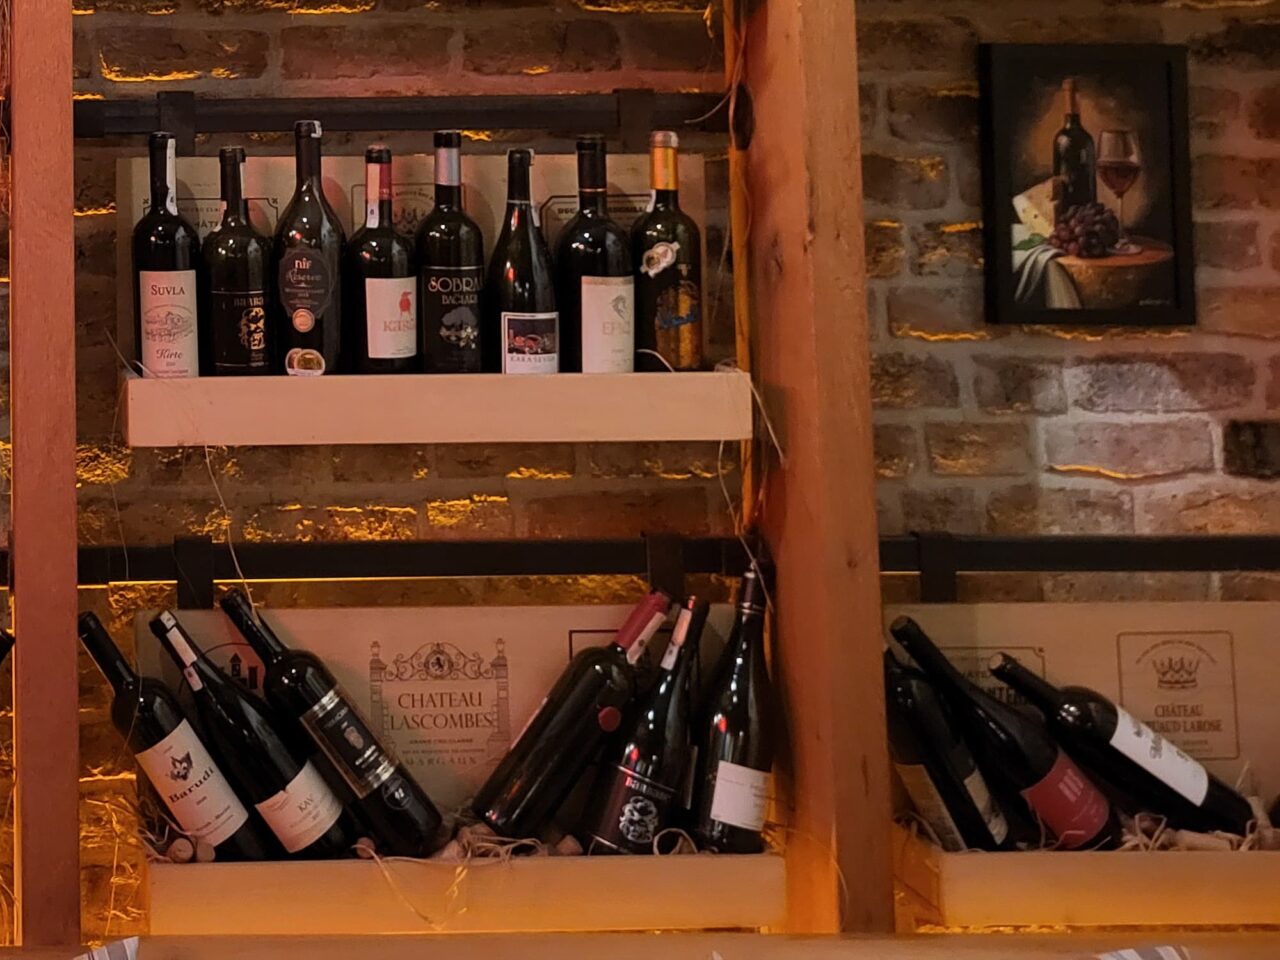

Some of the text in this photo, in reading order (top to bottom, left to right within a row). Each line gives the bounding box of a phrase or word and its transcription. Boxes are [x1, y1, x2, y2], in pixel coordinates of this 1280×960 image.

[151, 285, 185, 295] SUVLA
[398, 691, 482, 709] CHATEAU
[390, 712, 494, 730] LASCOMBES
[169, 767, 214, 803] Barudi
